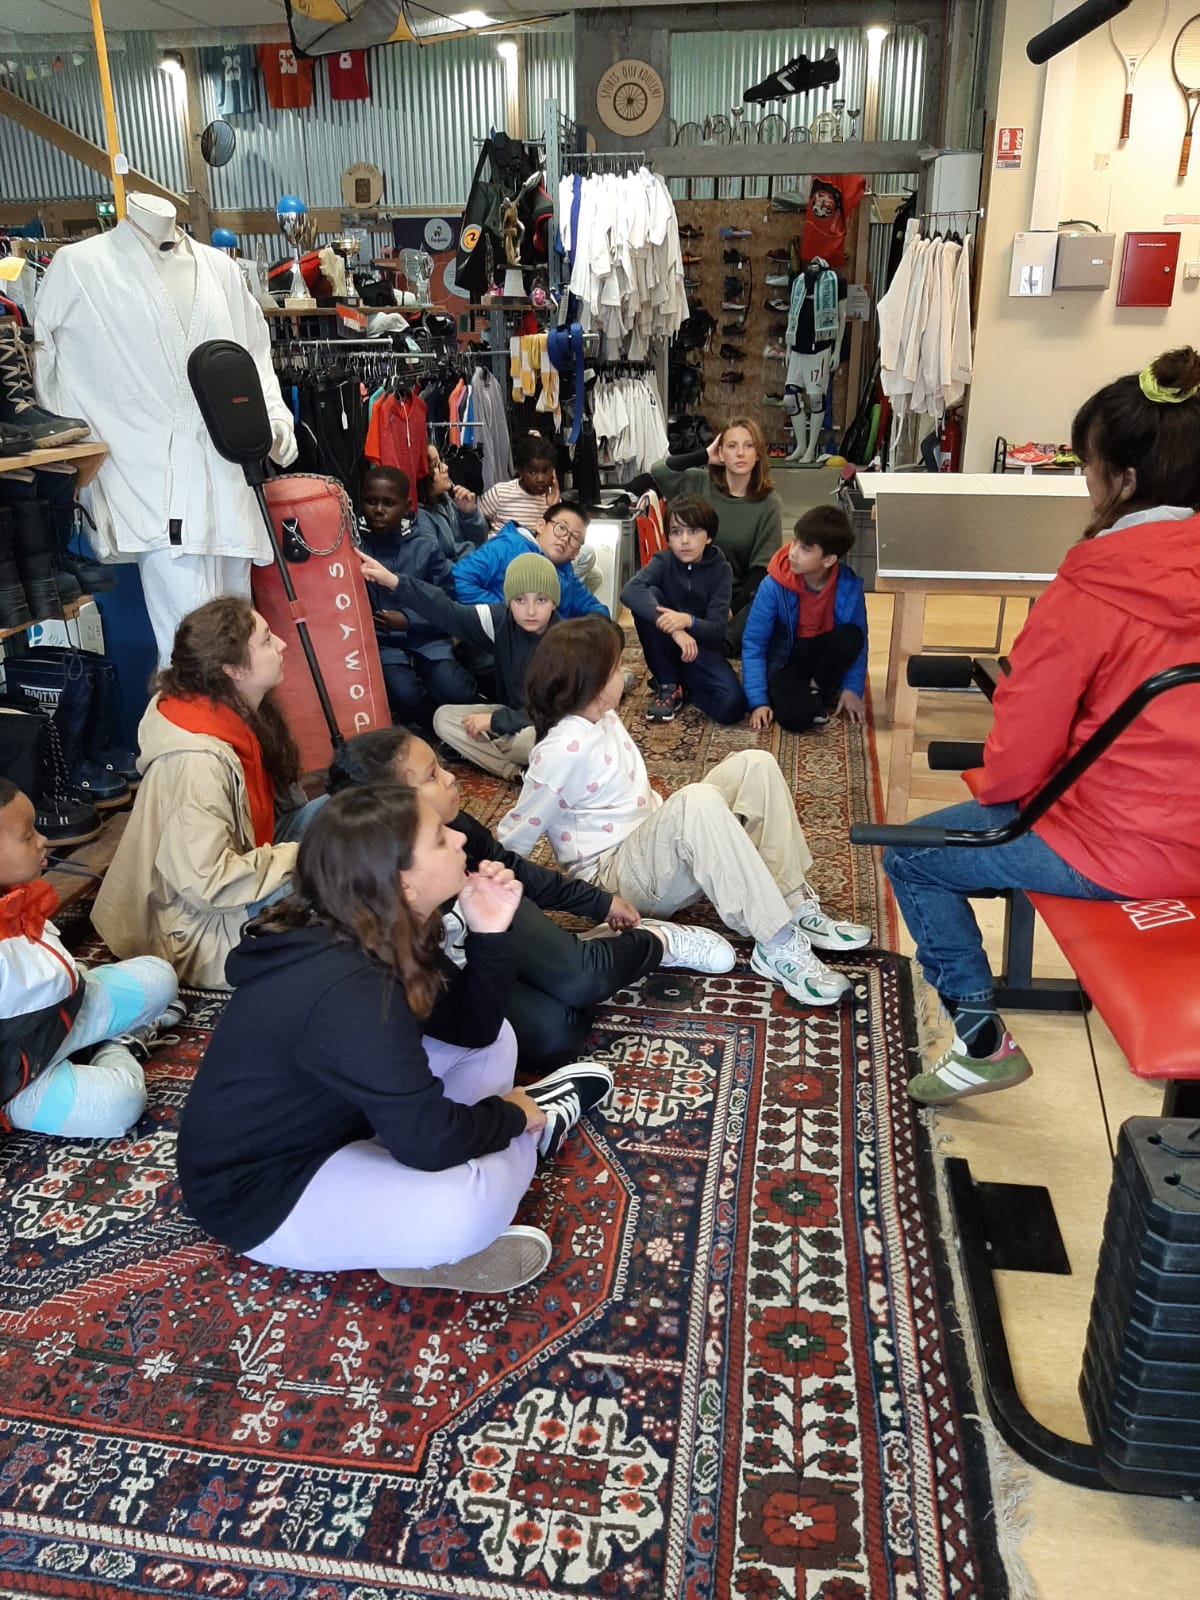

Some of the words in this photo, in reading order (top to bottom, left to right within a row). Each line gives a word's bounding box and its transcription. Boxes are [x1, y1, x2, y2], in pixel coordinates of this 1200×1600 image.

[600, 72, 620, 99] SPORTS
[622, 65, 637, 79] QUI
[638, 67, 662, 98] ROULENT
[810, 369, 820, 382] 17
